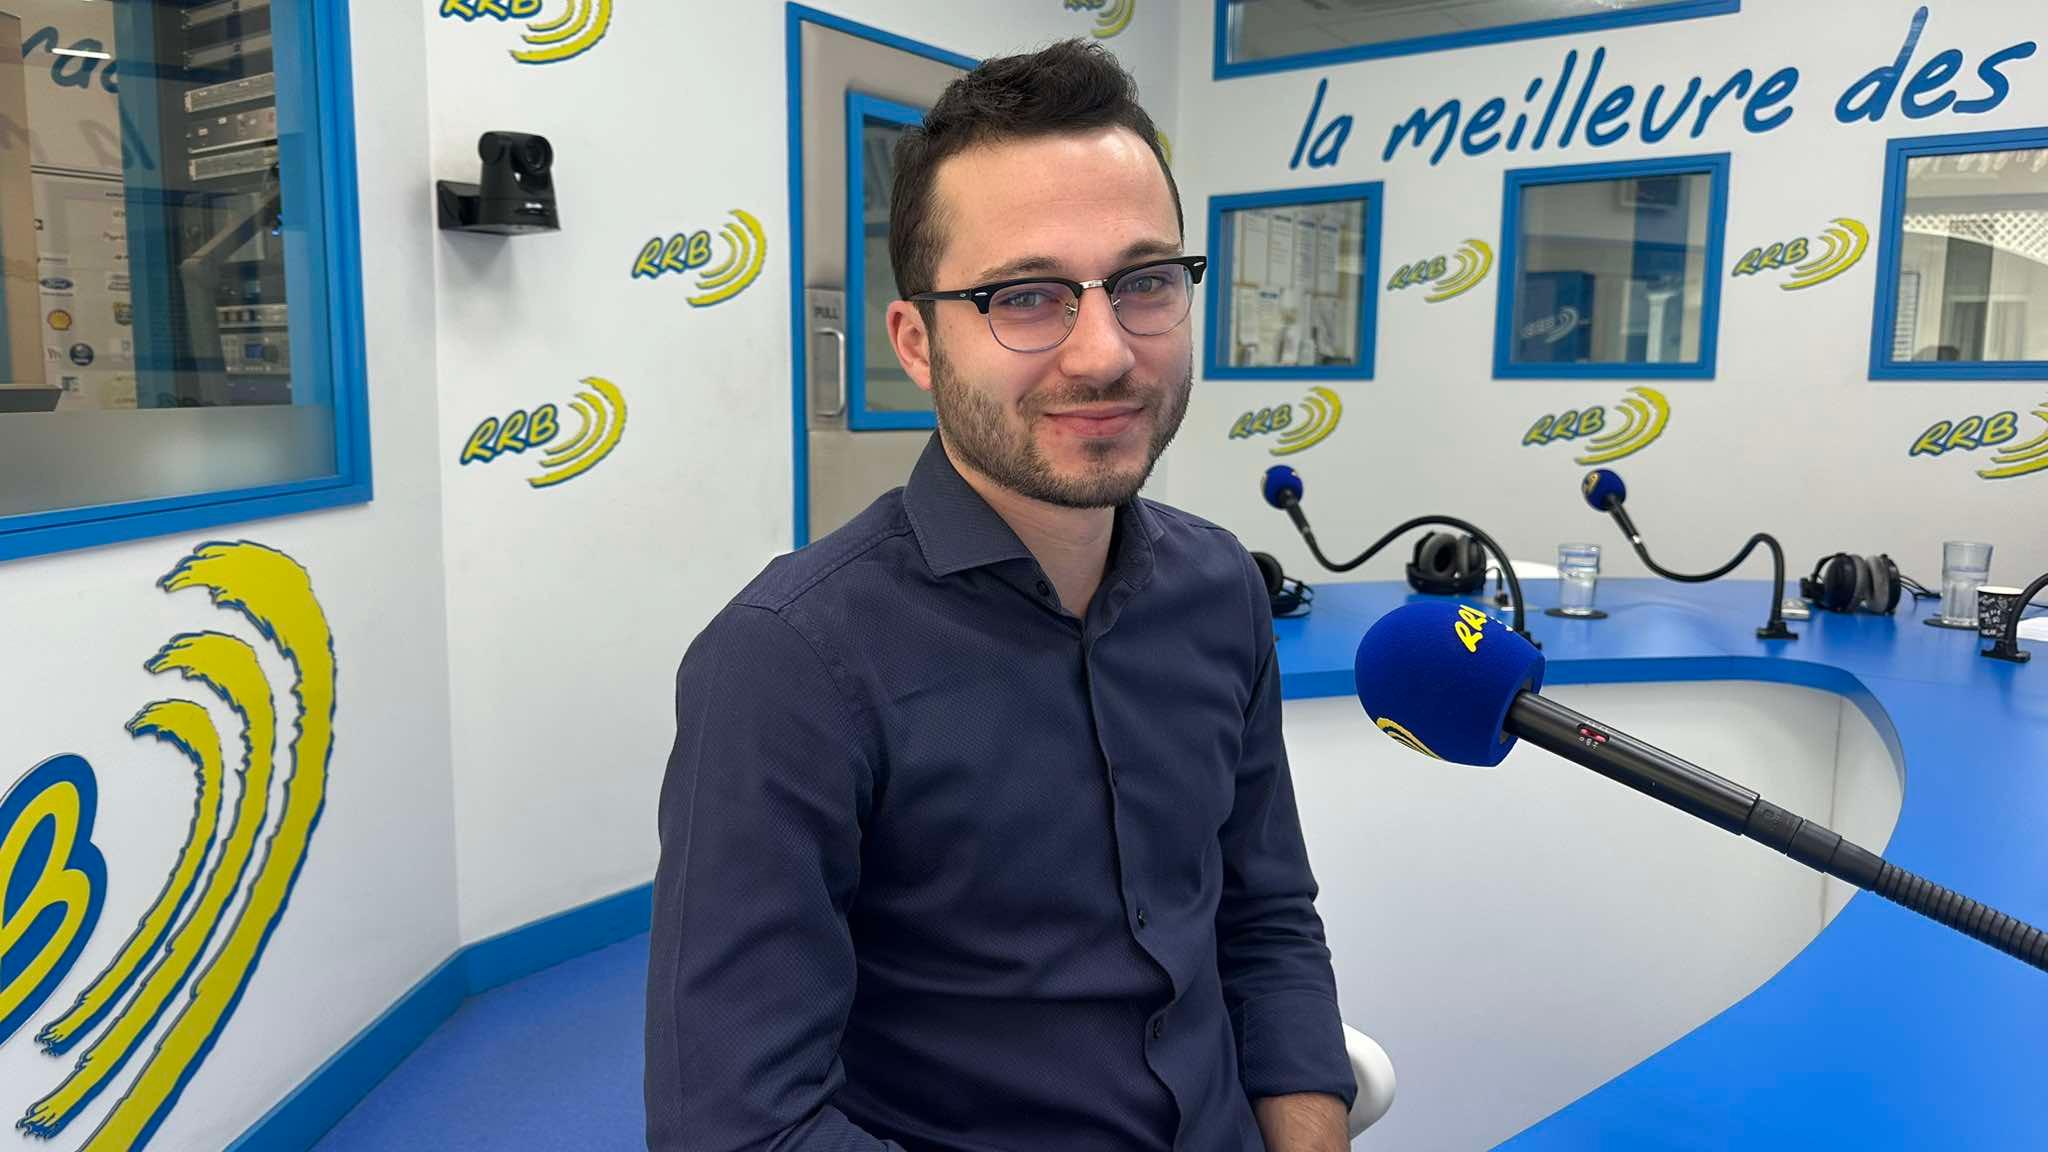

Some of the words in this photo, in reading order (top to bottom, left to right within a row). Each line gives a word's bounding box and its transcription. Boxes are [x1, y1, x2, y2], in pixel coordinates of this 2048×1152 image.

[1288, 78, 1353, 170] la
[1382, 46, 1799, 166] meilleure
[1835, 6, 2036, 123] des
[632, 231, 712, 278] RRB
[1386, 255, 1446, 291] RRB
[1732, 237, 1808, 277] RRB
[460, 403, 559, 464] RRB
[1229, 405, 1292, 439] RRB
[1522, 407, 1604, 446] RRB
[1909, 412, 2017, 459] RRB
